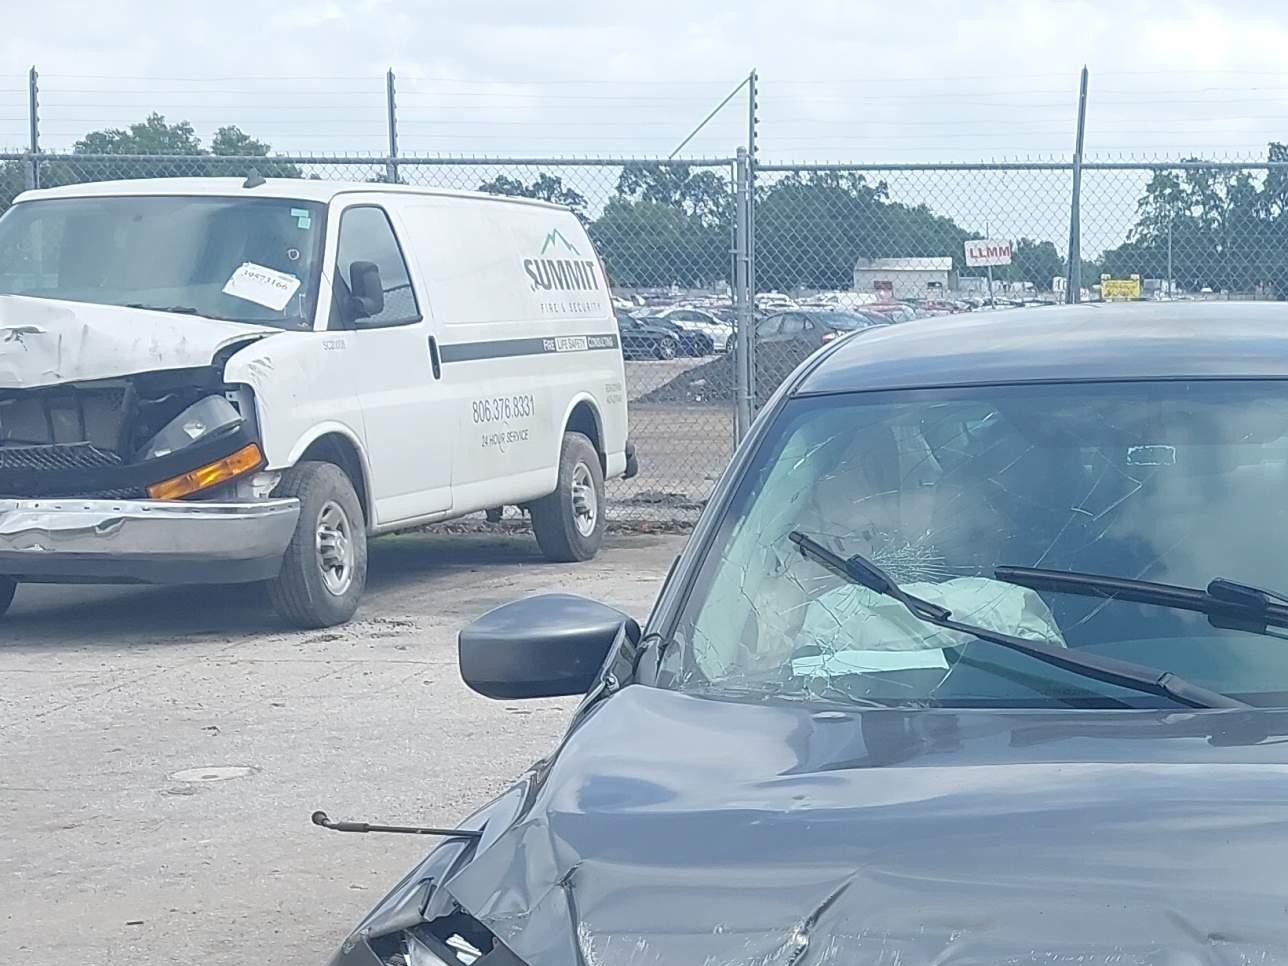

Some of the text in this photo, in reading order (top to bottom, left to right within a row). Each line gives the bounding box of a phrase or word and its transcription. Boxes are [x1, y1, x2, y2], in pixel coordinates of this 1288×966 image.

[969, 246, 1010, 259] LLMM
[523, 259, 599, 291] SUMMIT
[540, 303, 559, 313] FIRE
[568, 302, 601, 313] SECURITY
[472, 395, 535, 423] 806.376.8331
